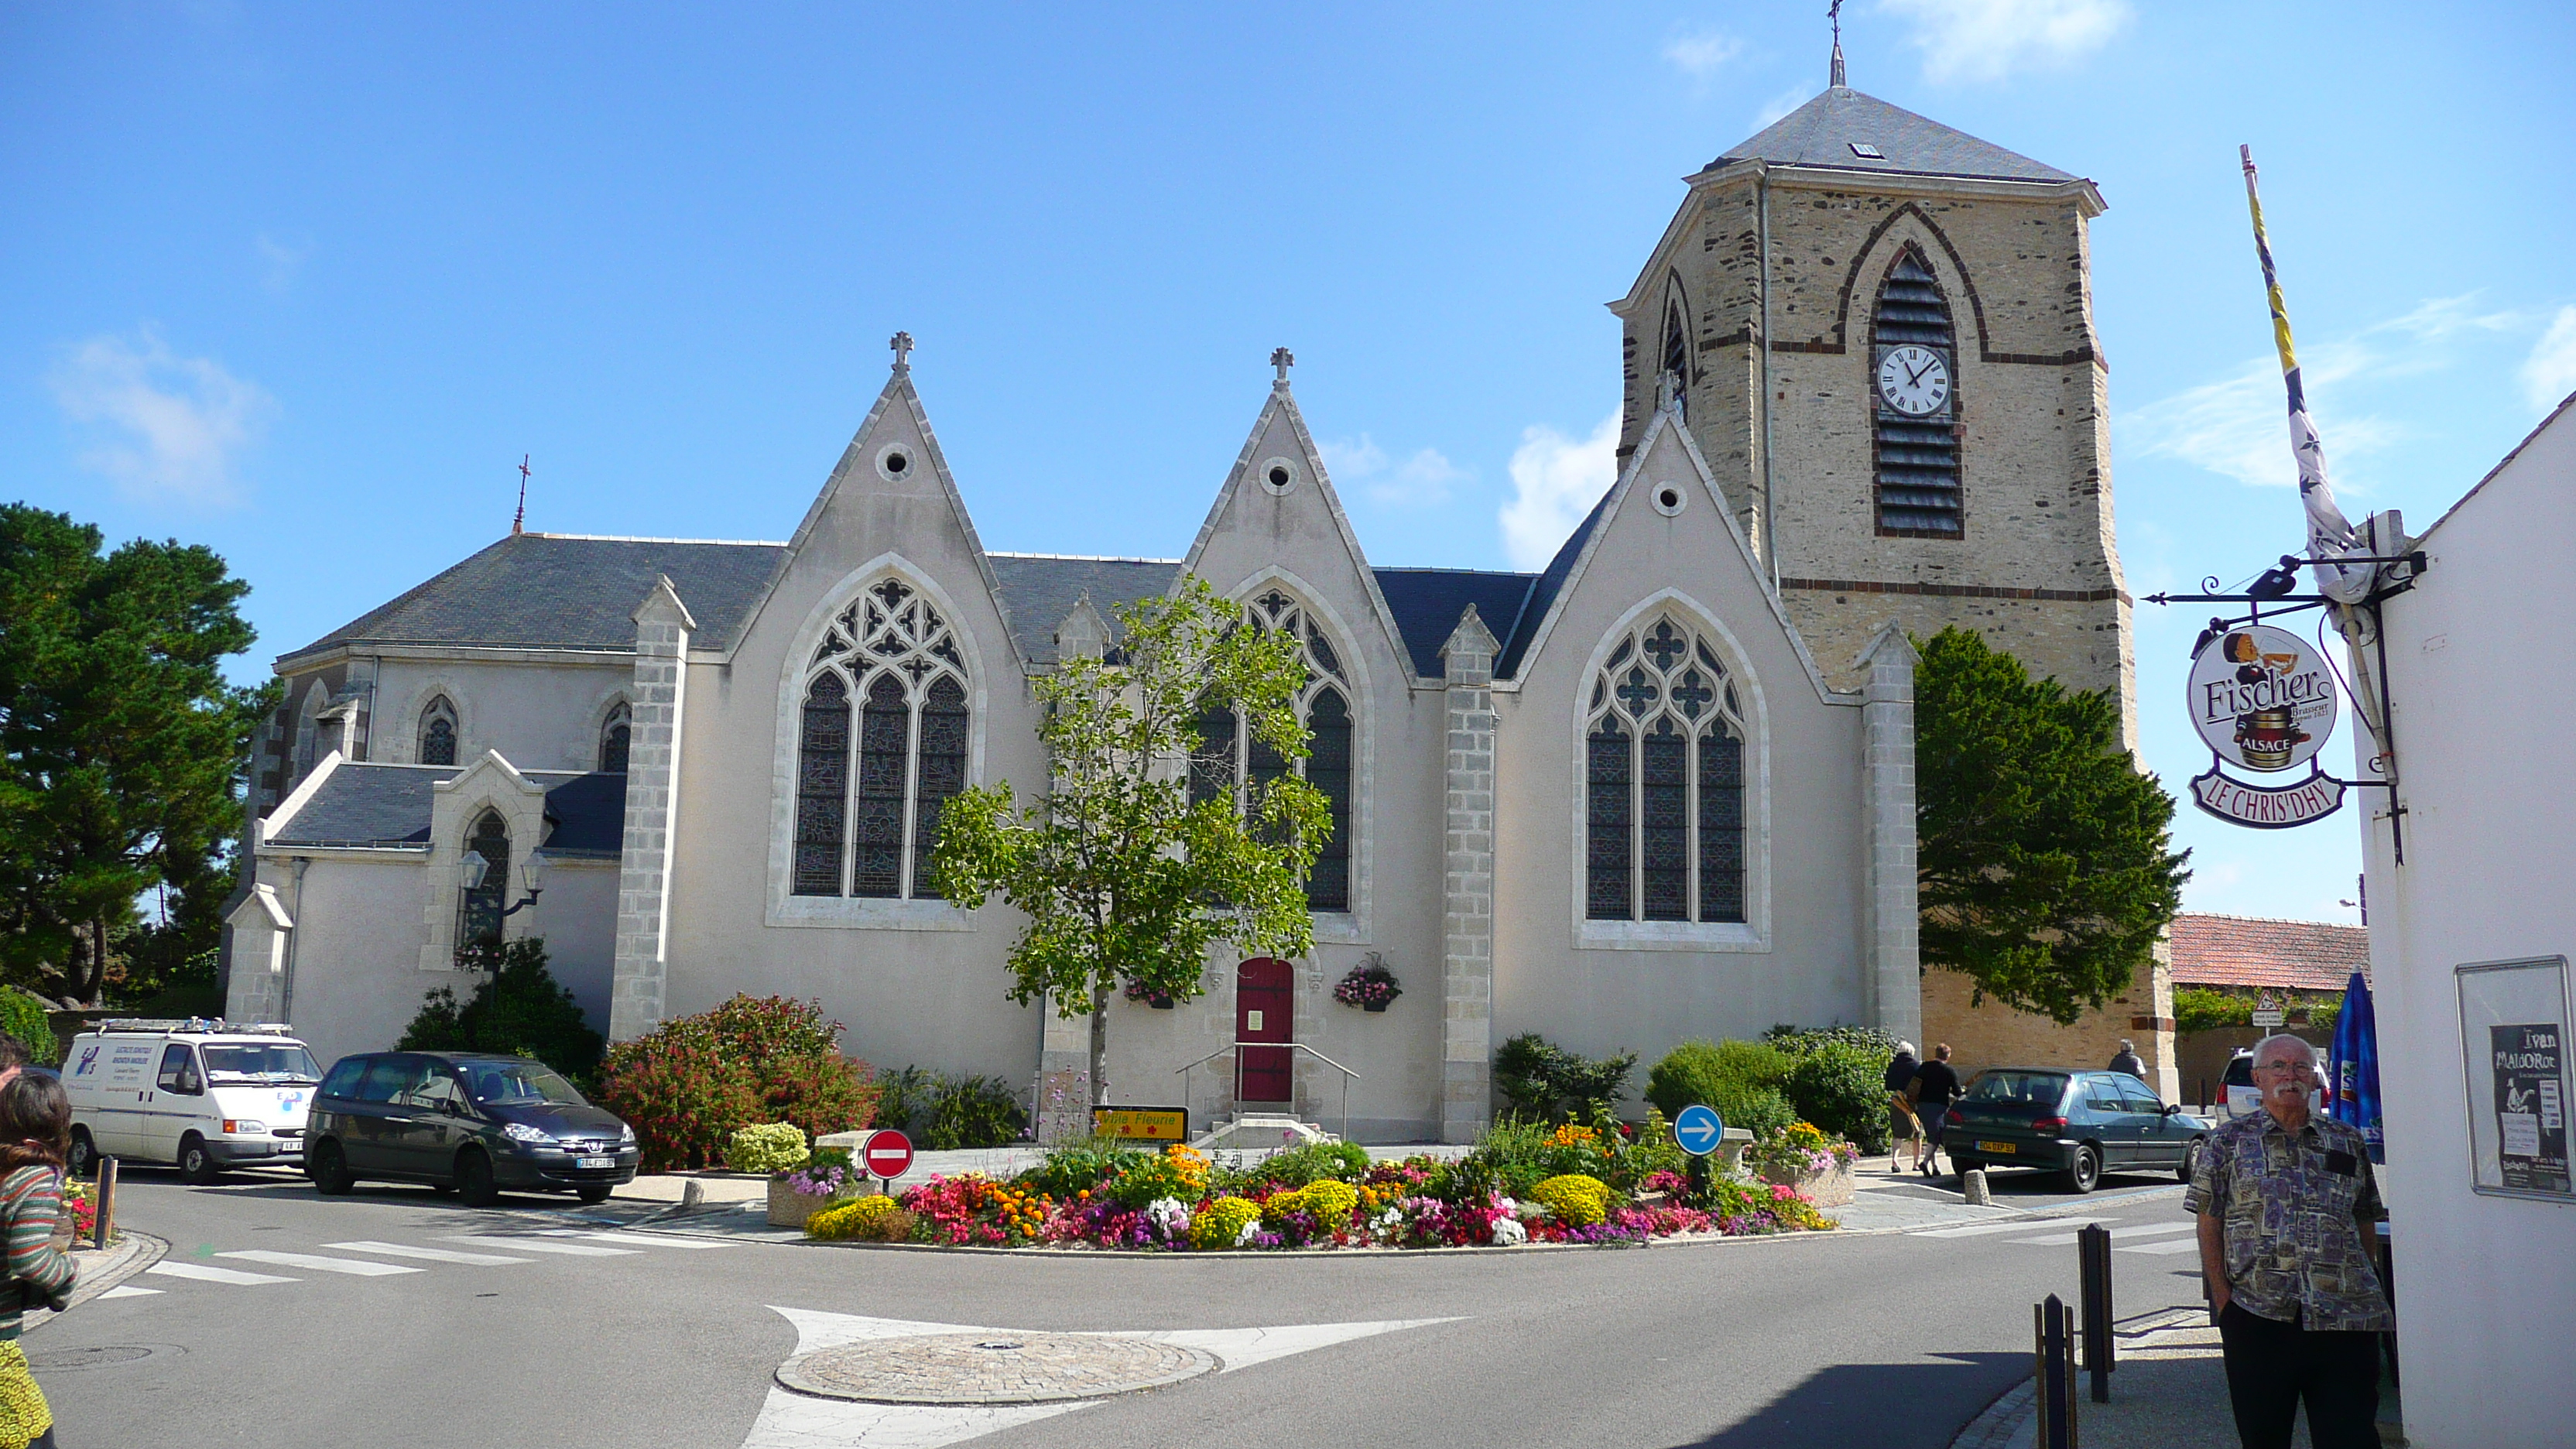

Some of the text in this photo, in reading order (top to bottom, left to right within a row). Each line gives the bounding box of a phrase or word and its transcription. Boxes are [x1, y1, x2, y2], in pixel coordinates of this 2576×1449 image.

[2203, 668, 2321, 718] Fischer
[2292, 703, 2328, 717] Brasseur
[2242, 738, 2291, 752] ALSACE
[2206, 779, 2331, 822] LE CHRIS'DHY
[2523, 1028, 2557, 1049] Ivan
[1103, 1113, 1176, 1125] Ville Fleurie
